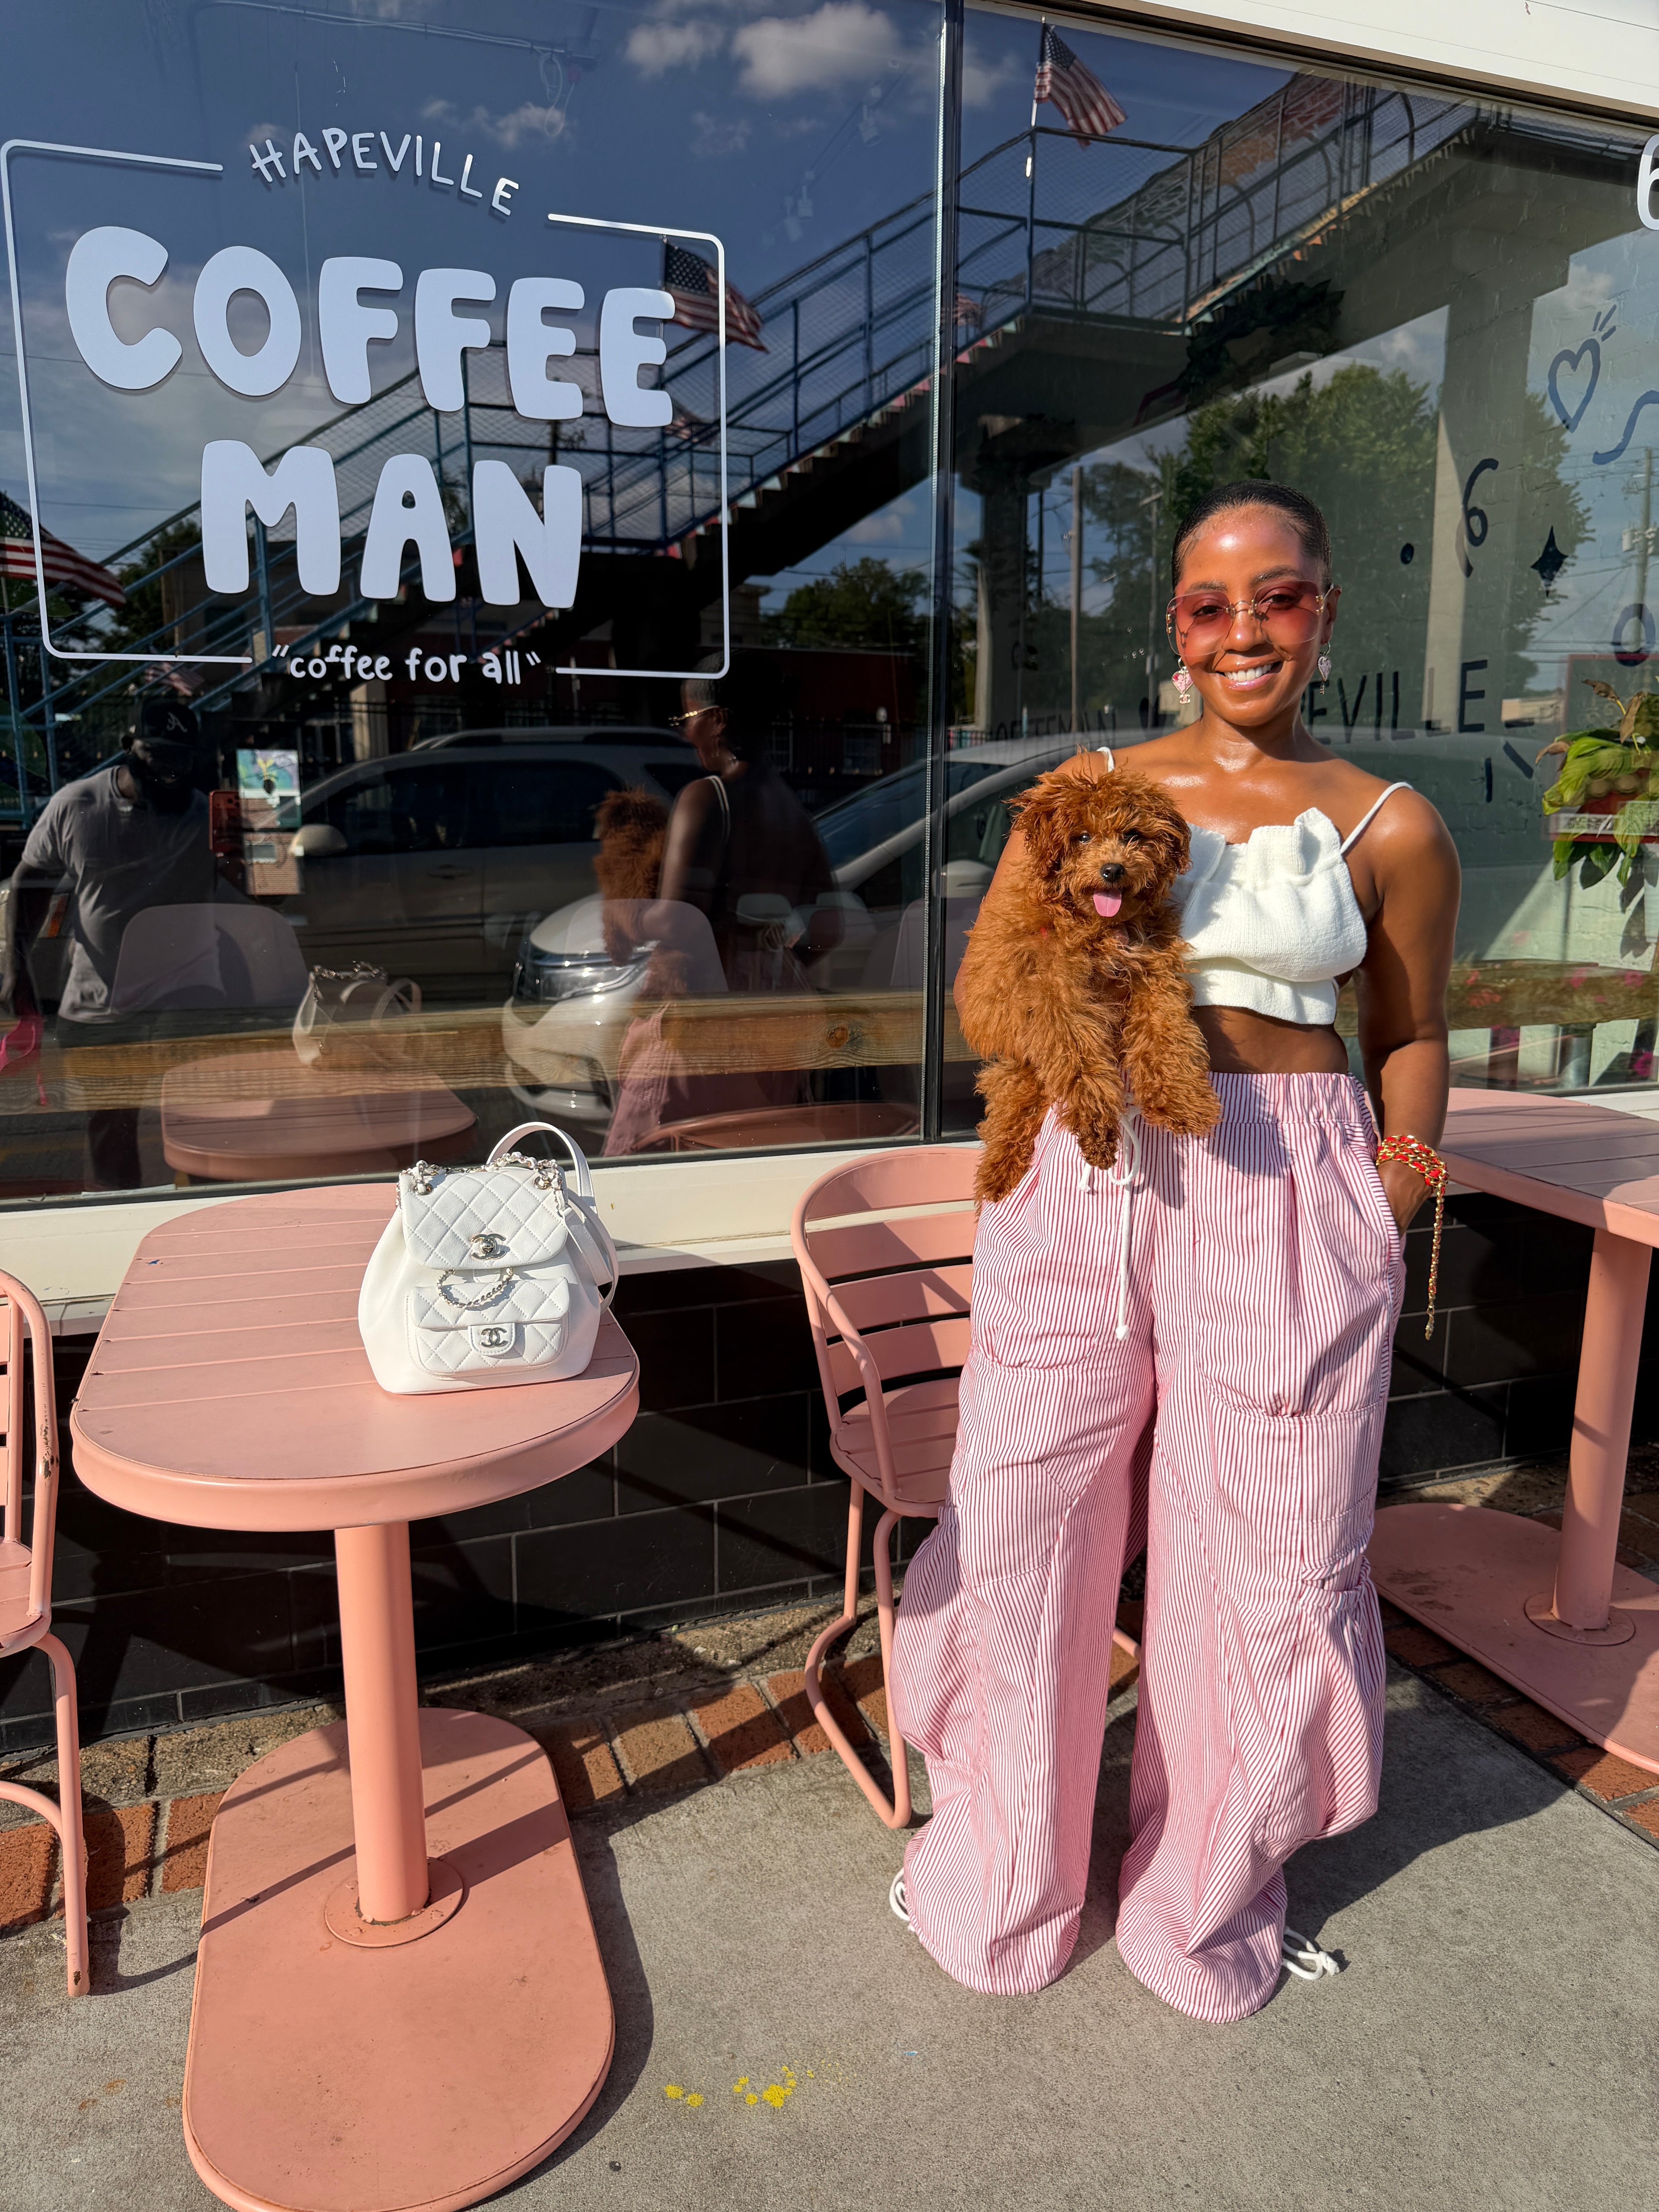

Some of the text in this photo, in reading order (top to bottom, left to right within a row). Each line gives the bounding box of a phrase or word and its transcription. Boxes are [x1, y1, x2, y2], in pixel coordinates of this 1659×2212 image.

[249, 127, 519, 216] HAPEVILLE
[66, 226, 676, 427] COFFEE
[201, 439, 582, 608] MAN
[405, 648, 467, 682] for
